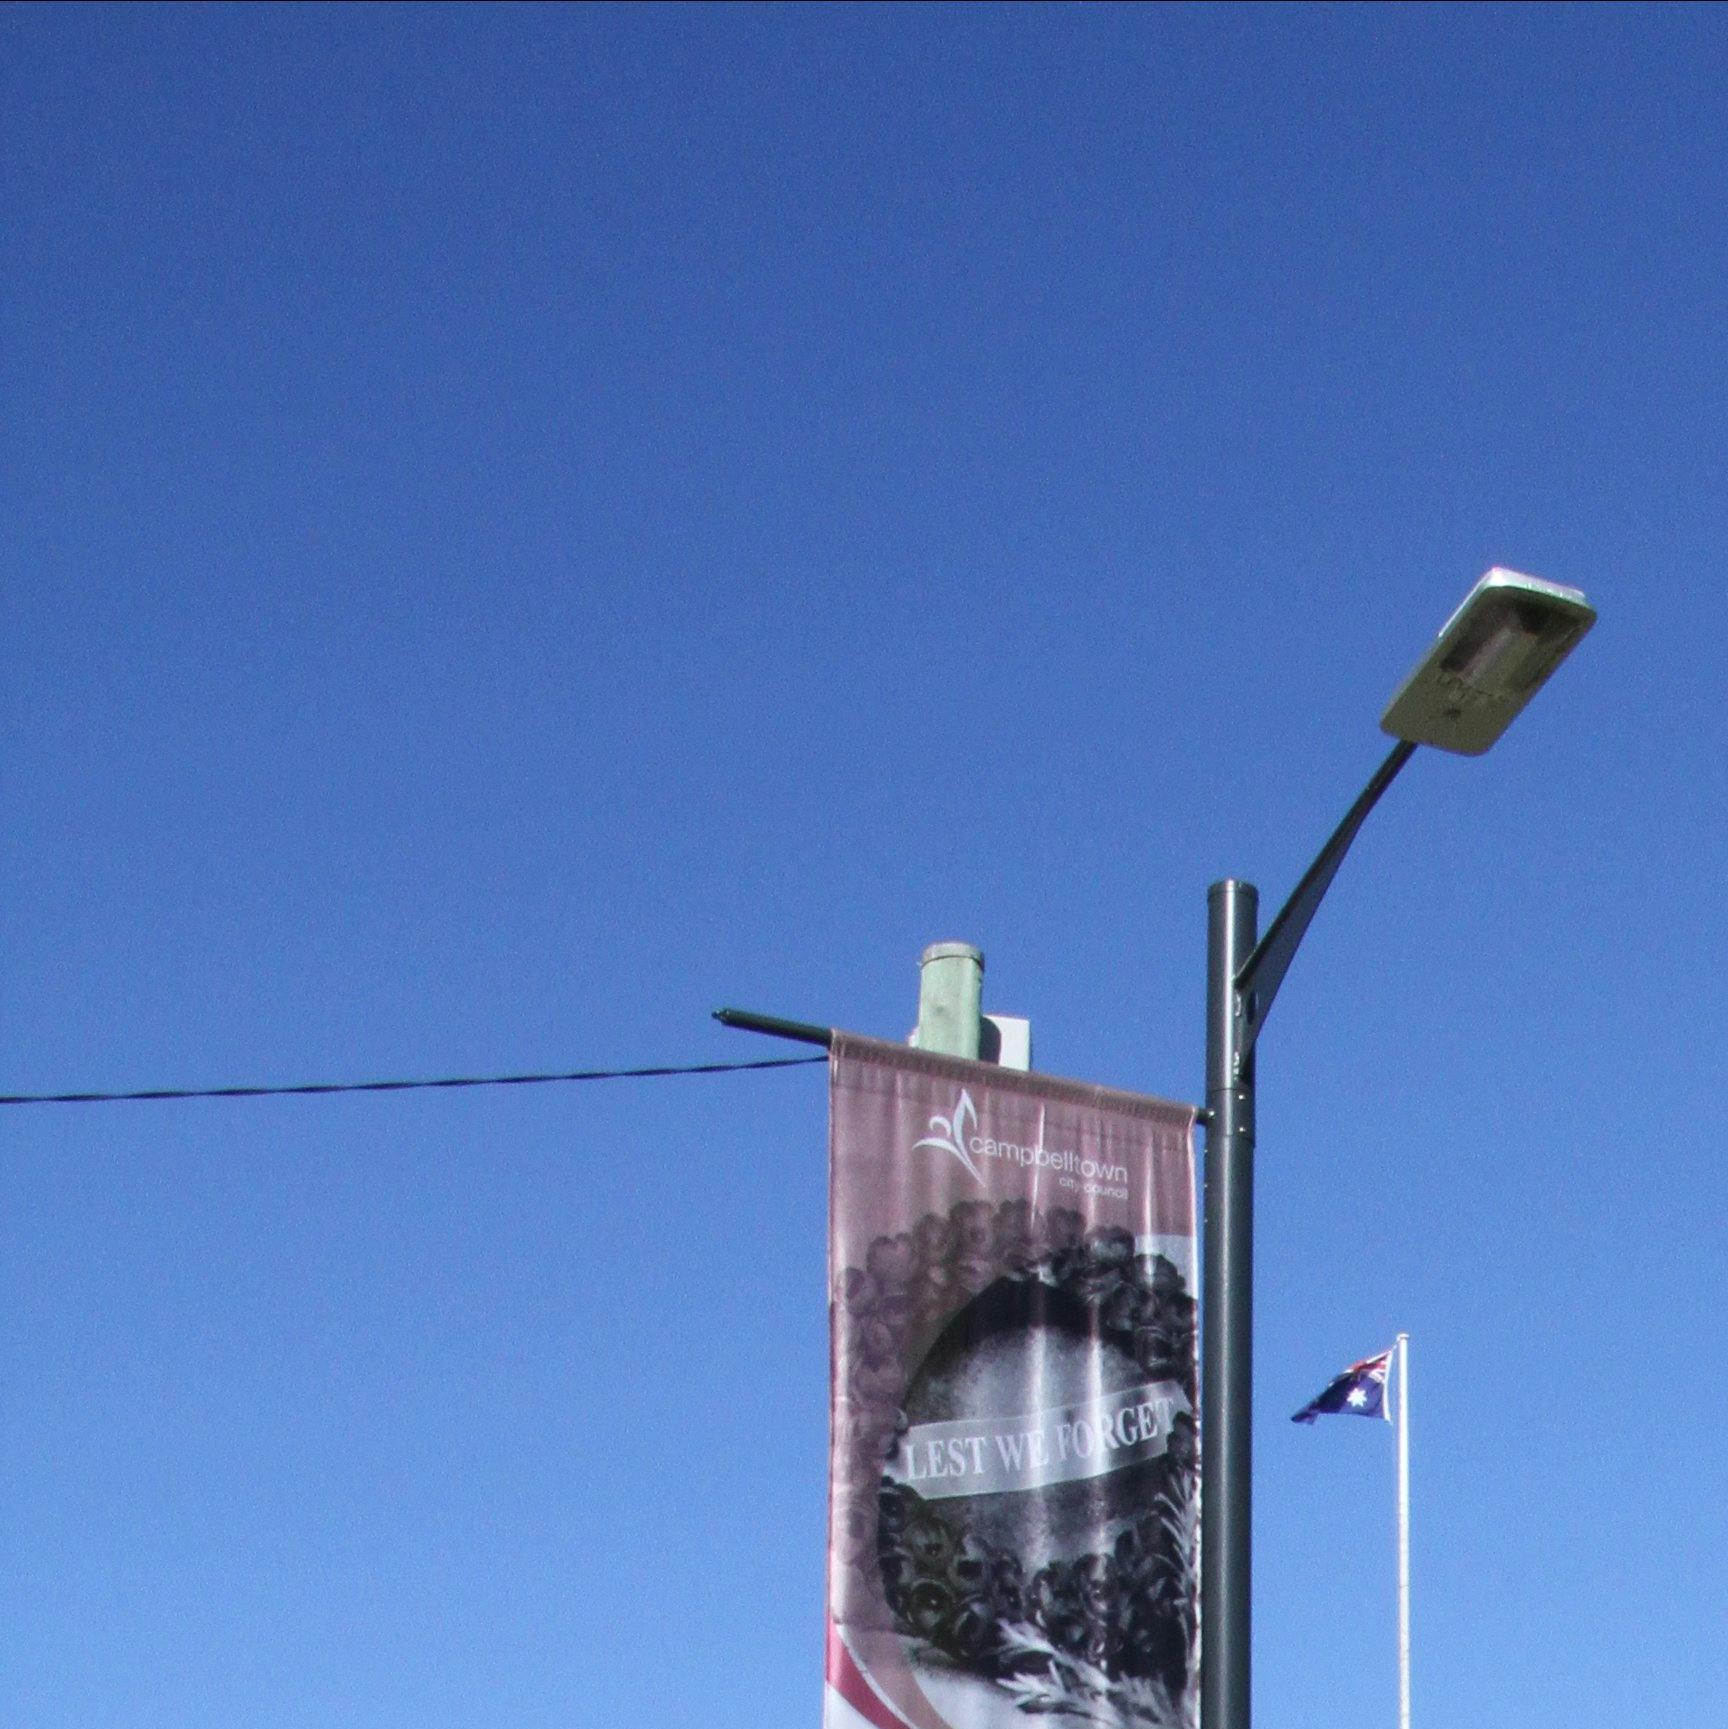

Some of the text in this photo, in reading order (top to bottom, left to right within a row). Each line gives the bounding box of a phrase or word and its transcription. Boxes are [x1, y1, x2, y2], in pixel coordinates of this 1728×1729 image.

[969, 1136, 1128, 1184] campbelltown
[1083, 1181, 1130, 1200] council
[904, 1398, 1174, 1481] LEST WE FORGET
